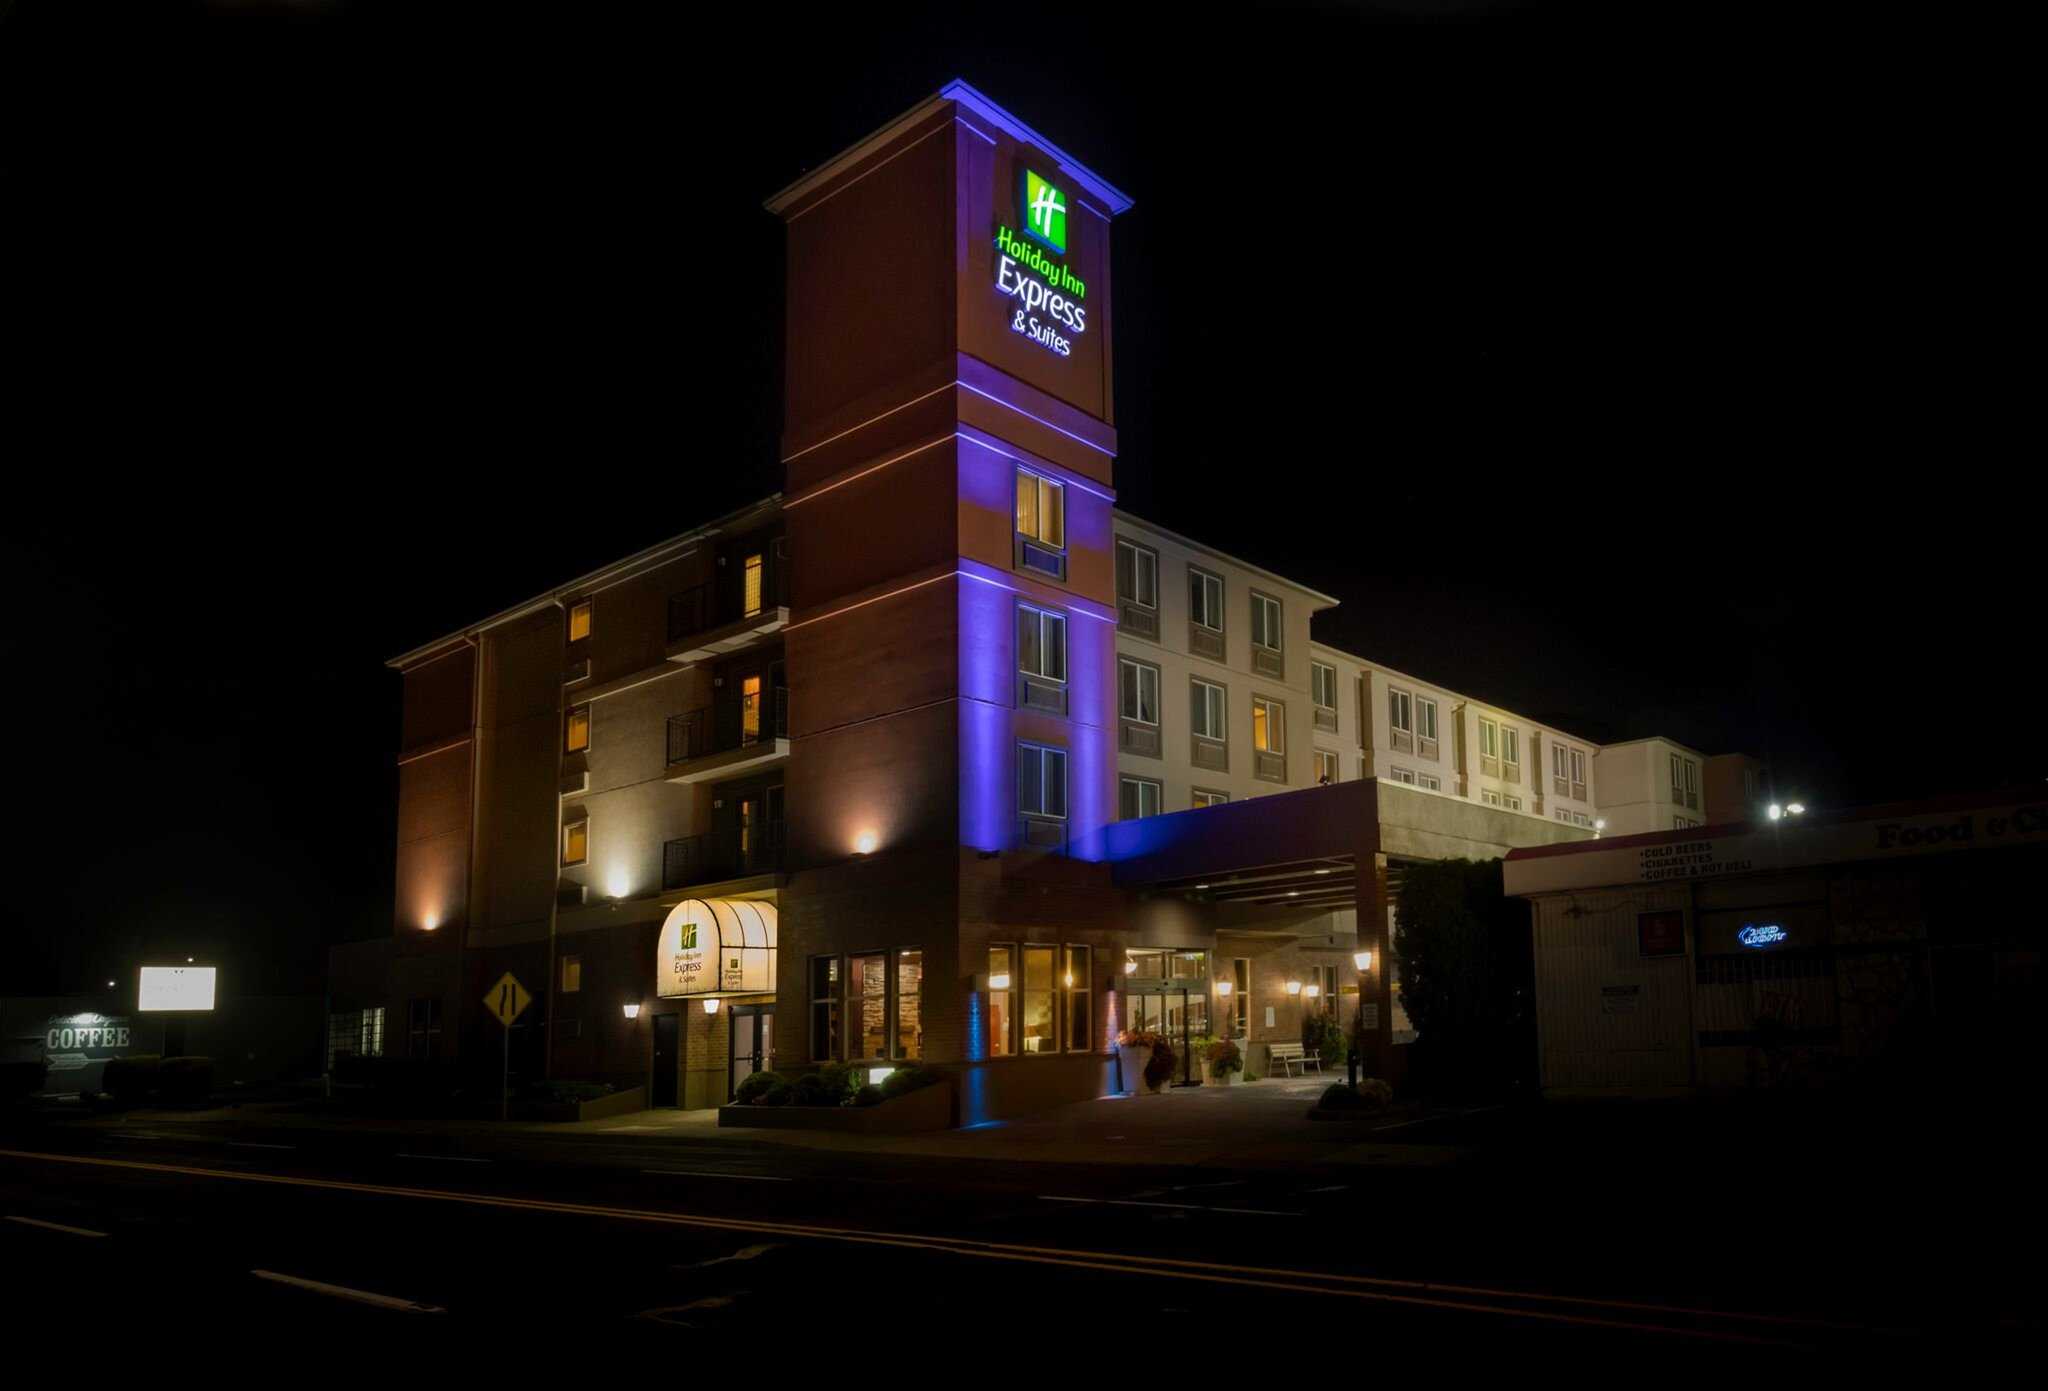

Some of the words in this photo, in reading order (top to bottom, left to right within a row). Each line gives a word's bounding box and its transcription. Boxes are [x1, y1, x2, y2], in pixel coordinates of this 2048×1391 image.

[998, 225, 1060, 286] Holiday
[1062, 264, 1086, 299] Inn
[998, 253, 1086, 332] Express
[1012, 309, 1026, 333] &
[1027, 316, 1071, 356] Suites
[674, 961, 702, 975] Express
[47, 1027, 130, 1049] COFFEE
